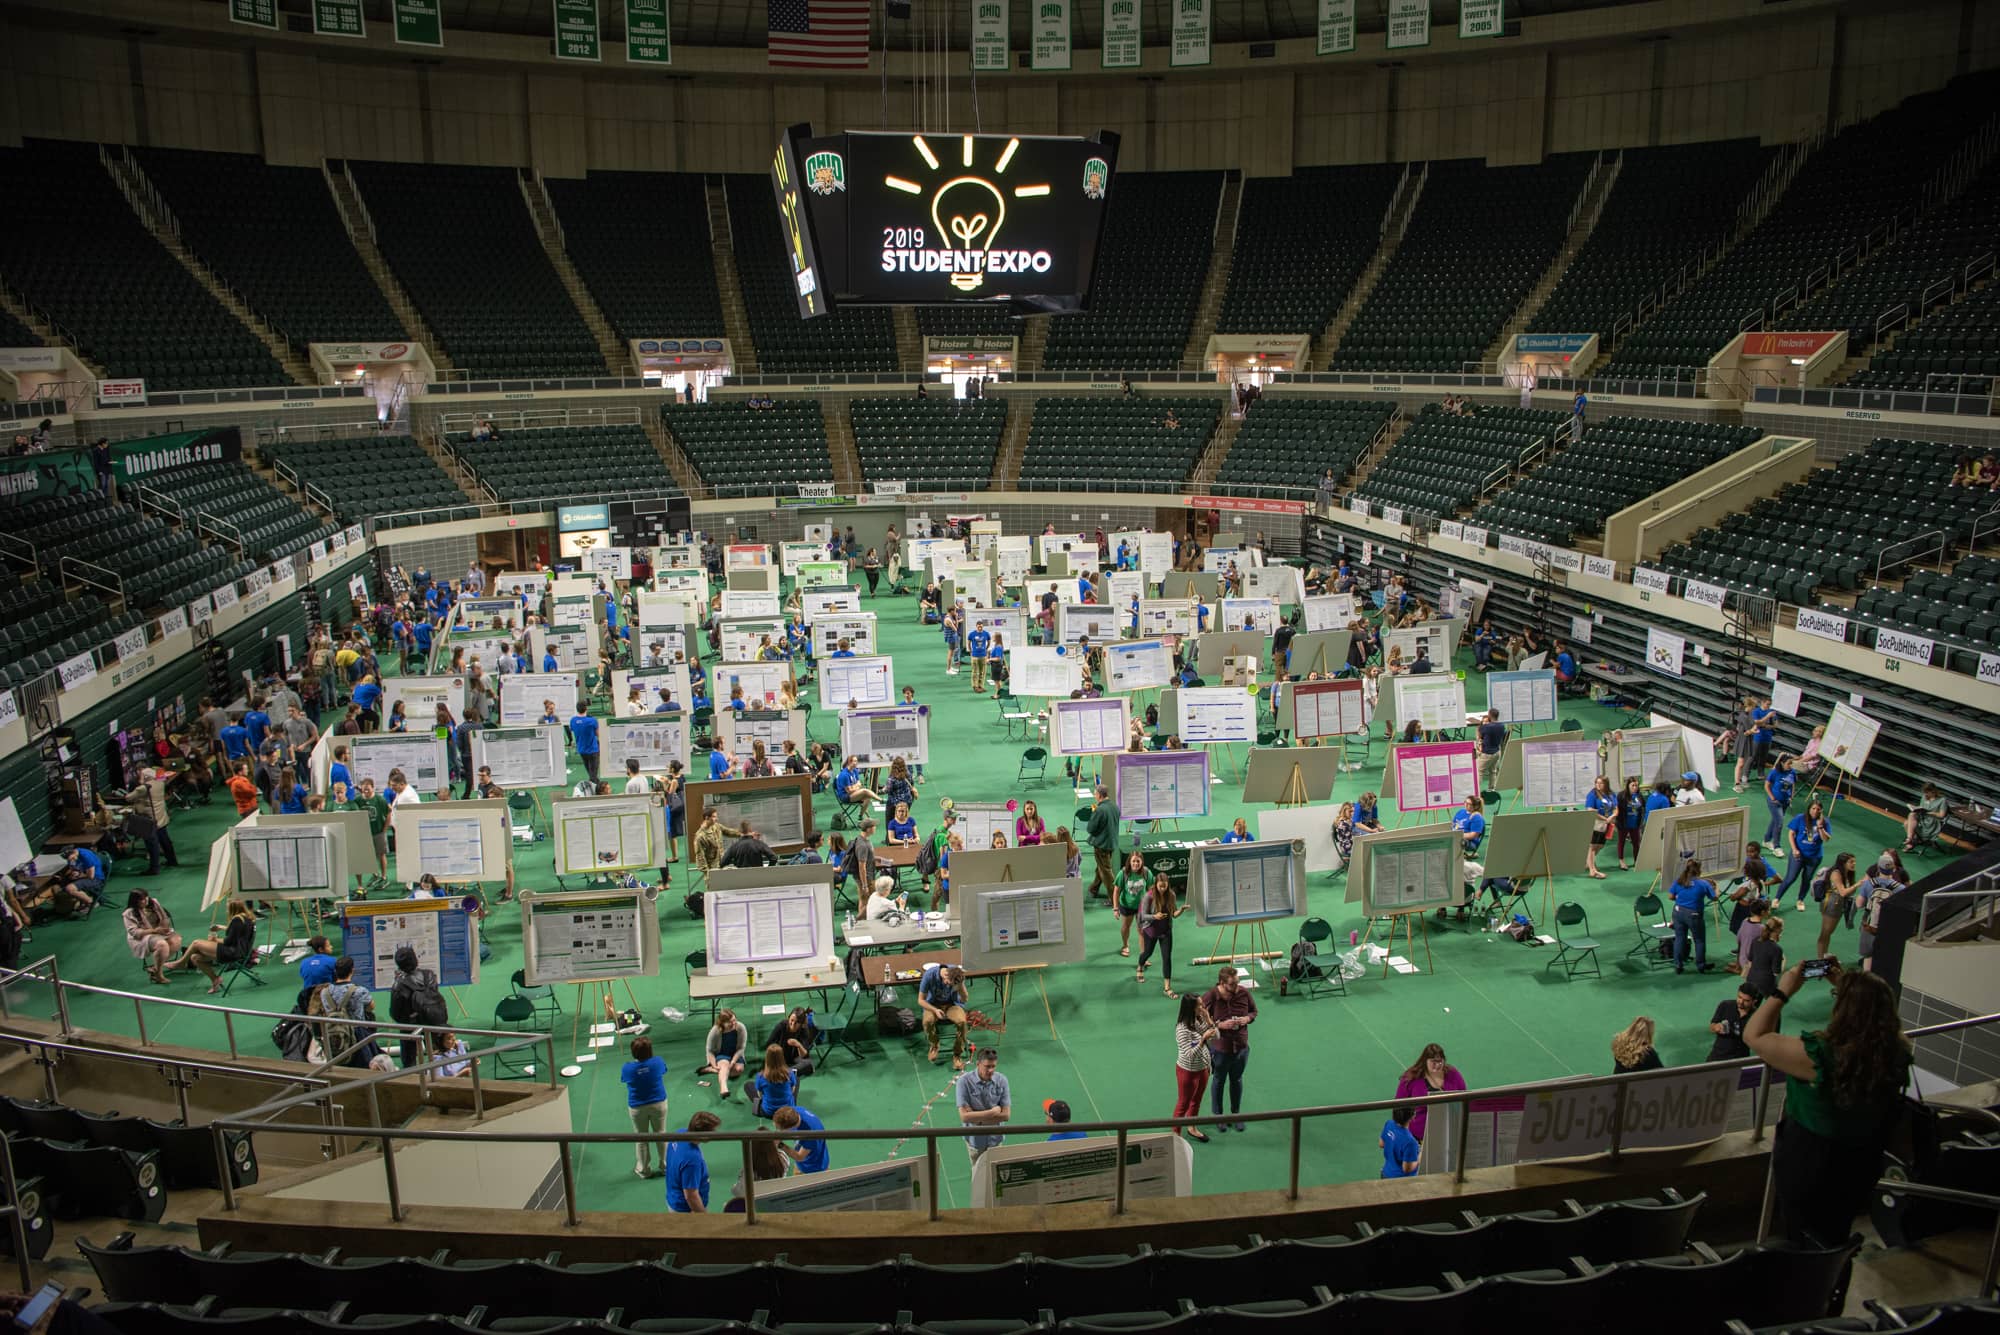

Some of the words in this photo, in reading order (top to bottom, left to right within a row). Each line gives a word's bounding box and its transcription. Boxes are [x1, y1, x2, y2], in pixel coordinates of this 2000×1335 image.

[980, 4, 1001, 18] OHIO
[1041, 4, 1062, 18] OHIO
[1112, 1, 1133, 15] OHIO
[1182, 0, 1202, 13] OHIO
[1391, 10, 1428, 19] TOURNAMENT
[1464, 10, 1488, 19] SWEET
[1489, 8, 1498, 17] 16
[1470, 20, 1492, 32] 2005
[562, 32, 584, 41] SWEET
[585, 34, 594, 42] 16
[630, 36, 647, 44] ELITE
[648, 37, 666, 45] EIGHT
[568, 44, 590, 55] 2012
[639, 47, 659, 57] 1964
[805, 152, 844, 182] OHIO
[1083, 158, 1108, 188] OHIO
[883, 228, 924, 248] 2019
[881, 250, 984, 273] STUDENT
[987, 250, 1051, 273] EXPO
[940, 340, 969, 349] Holzer
[984, 340, 1012, 349] Holzer
[1778, 338, 1789, 347] I'm
[1790, 338, 1808, 348] lovin'
[103, 383, 142, 396] ESPN
[1846, 410, 1881, 420] RESERVED
[125, 443, 222, 476] OhioBobcats.com
[800, 486, 829, 497] Theater
[877, 485, 896, 495] Theater
[1216, 500, 1235, 508] Frontier
[572, 513, 606, 524] OhioHealth
[1635, 571, 1649, 586] Environ
[1686, 584, 1695, 598] Soc
[1695, 585, 1704, 601] Pub
[1798, 612, 1844, 638] SocPubHlth-G3
[1878, 634, 1930, 660] SocPubHlth-G2
[1885, 658, 1900, 672] CS4
